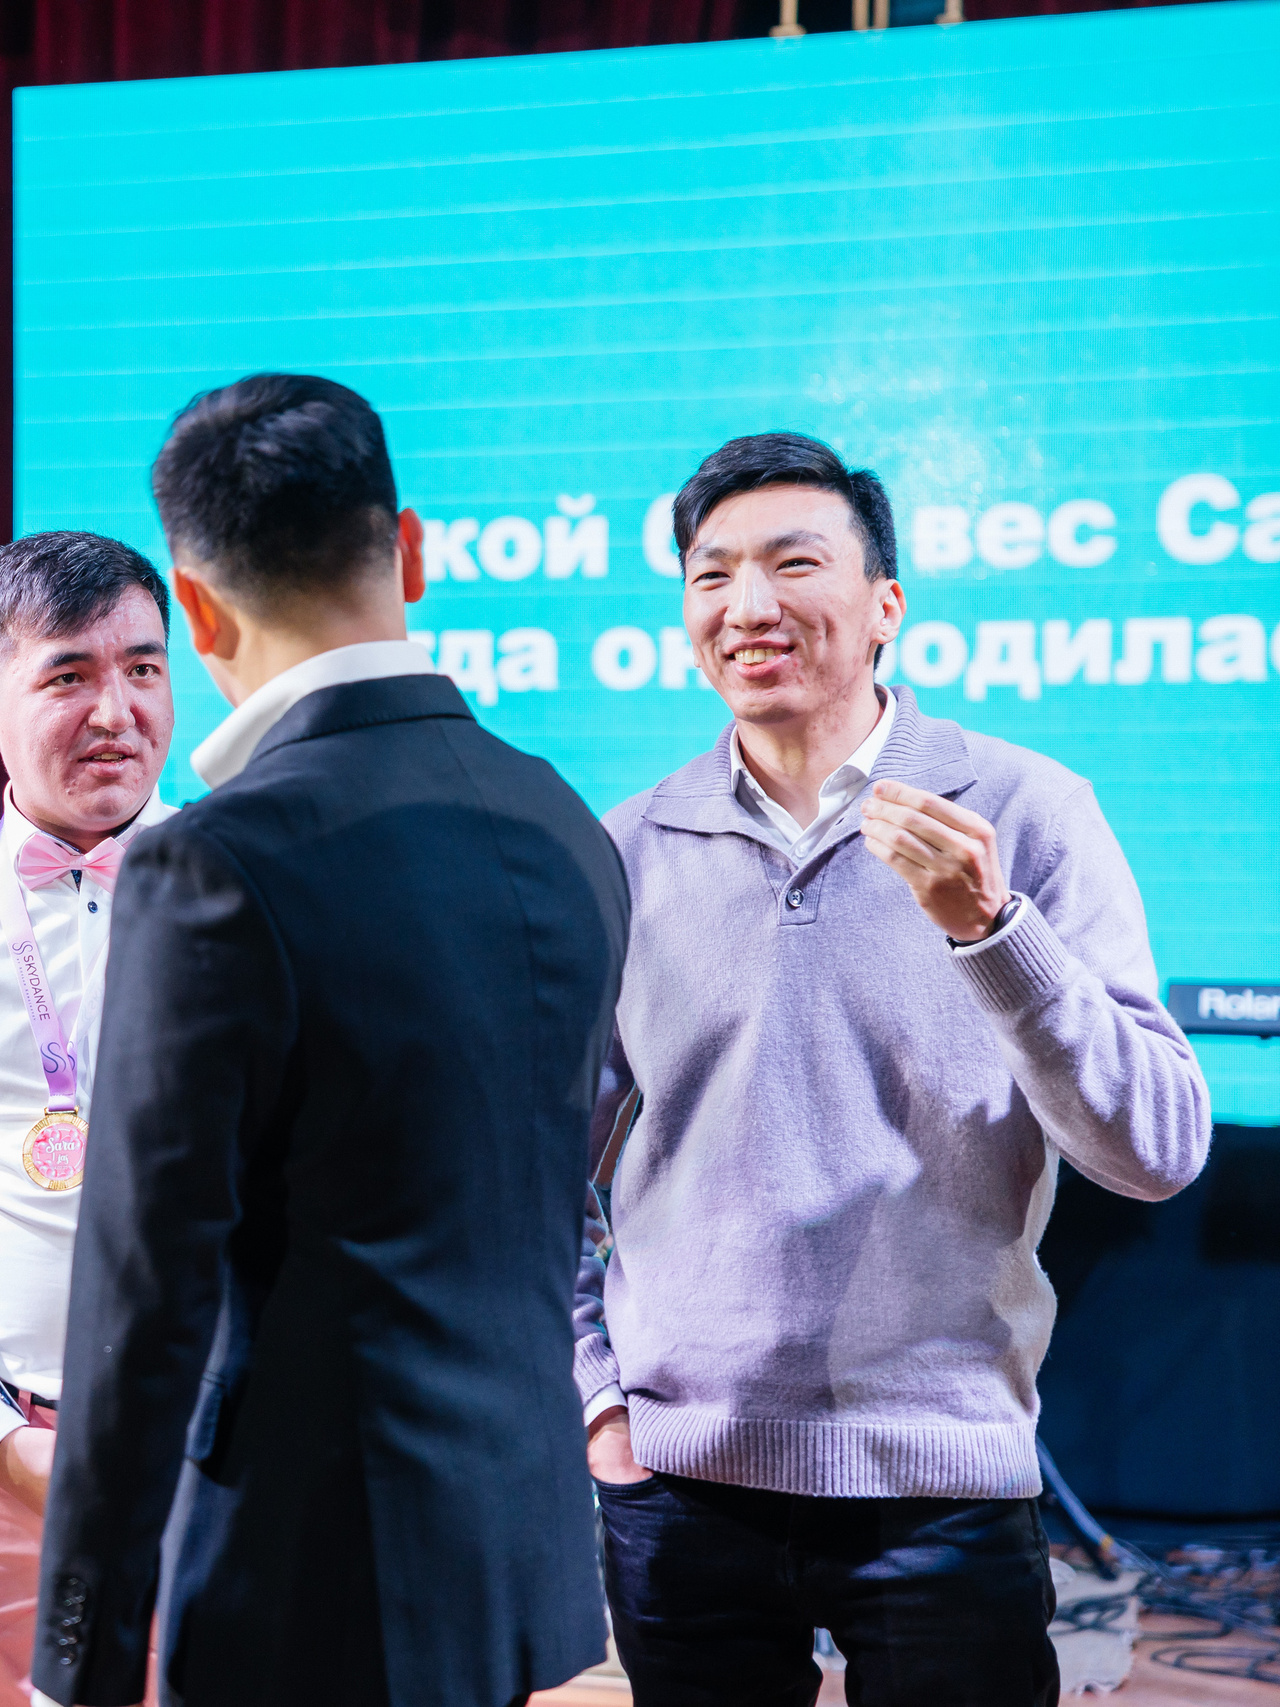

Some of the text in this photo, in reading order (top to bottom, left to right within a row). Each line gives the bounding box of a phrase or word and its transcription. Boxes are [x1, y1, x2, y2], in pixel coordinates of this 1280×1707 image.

[912, 498, 1117, 573] вес
[408, 626, 559, 707] да
[874, 613, 1280, 702] одила
[23, 954, 51, 1021] SKYDANCE
[45, 1137, 76, 1154] Sara
